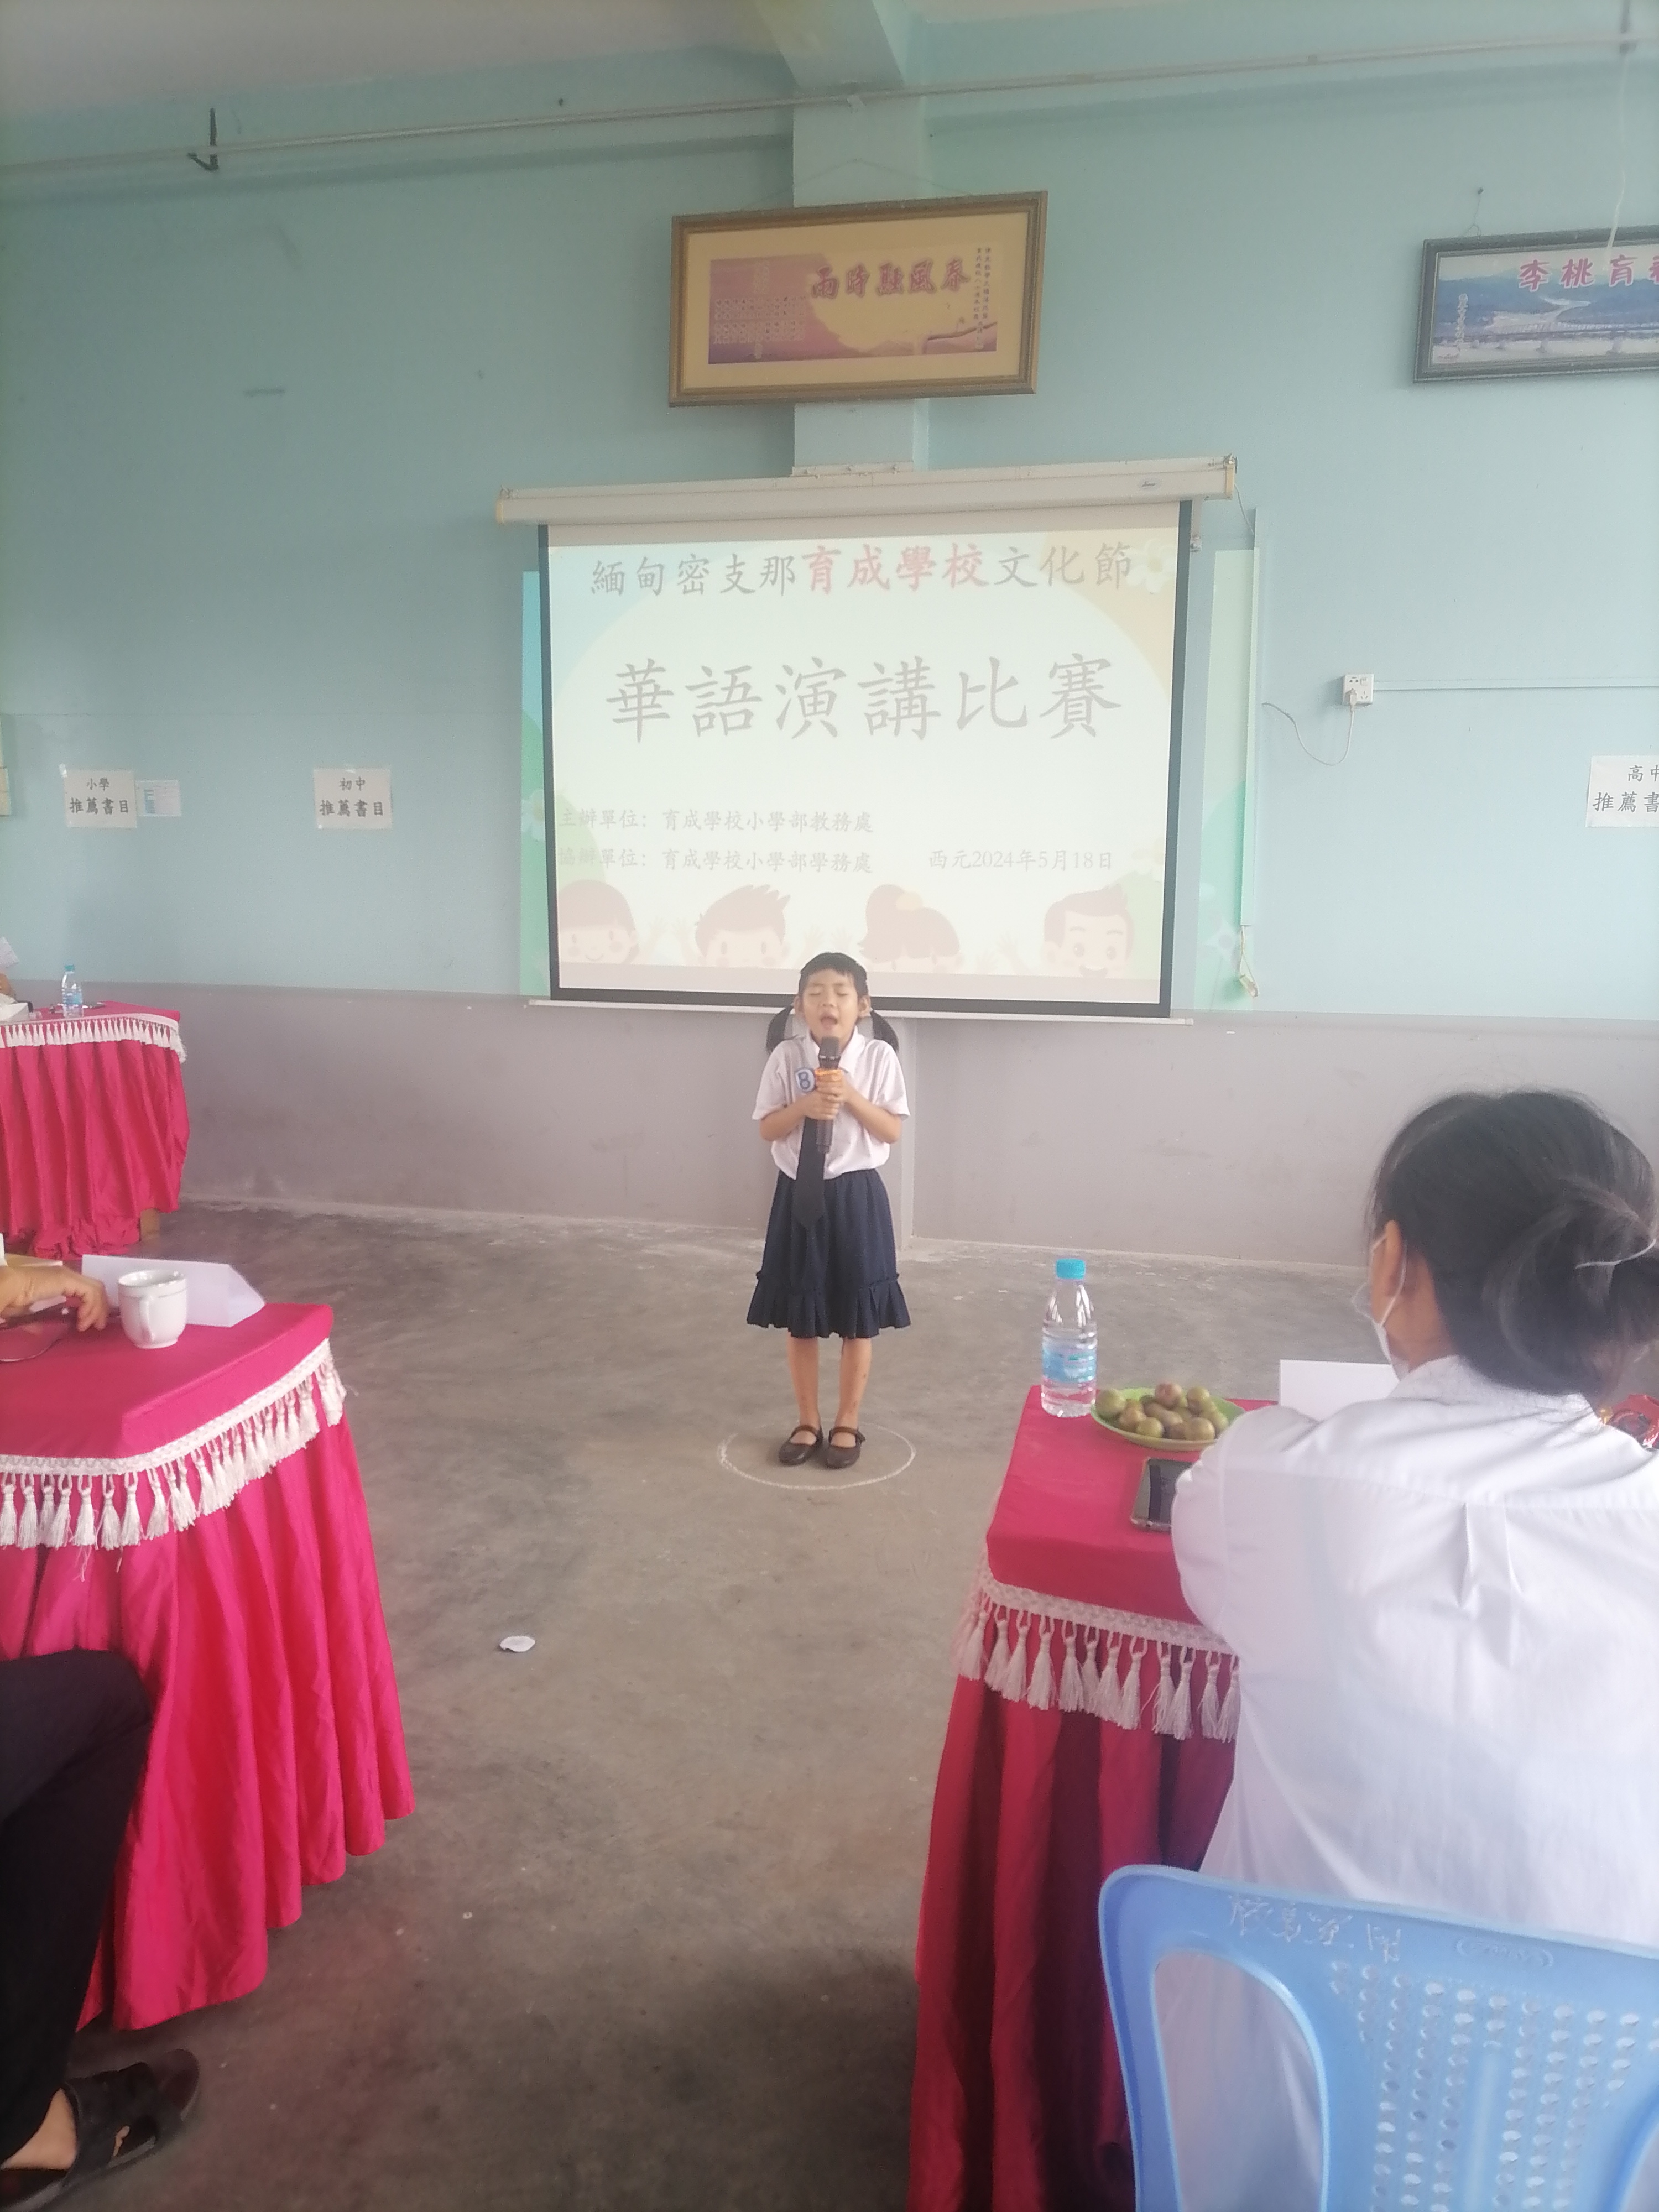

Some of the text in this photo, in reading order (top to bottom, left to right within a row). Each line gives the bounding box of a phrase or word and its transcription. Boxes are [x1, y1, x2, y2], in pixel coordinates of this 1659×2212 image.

[590, 543, 1132, 597] 緬甸密支那育成學校文化節
[605, 653, 1121, 744] 華語演講比賽
[86, 778, 109, 791] 小學
[338, 777, 366, 791] 初中
[662, 809, 874, 834] 育成學校小學部教務處
[661, 848, 873, 874] 育成學校小學部學務處
[928, 849, 1113, 871] 西元2024年5月18日
